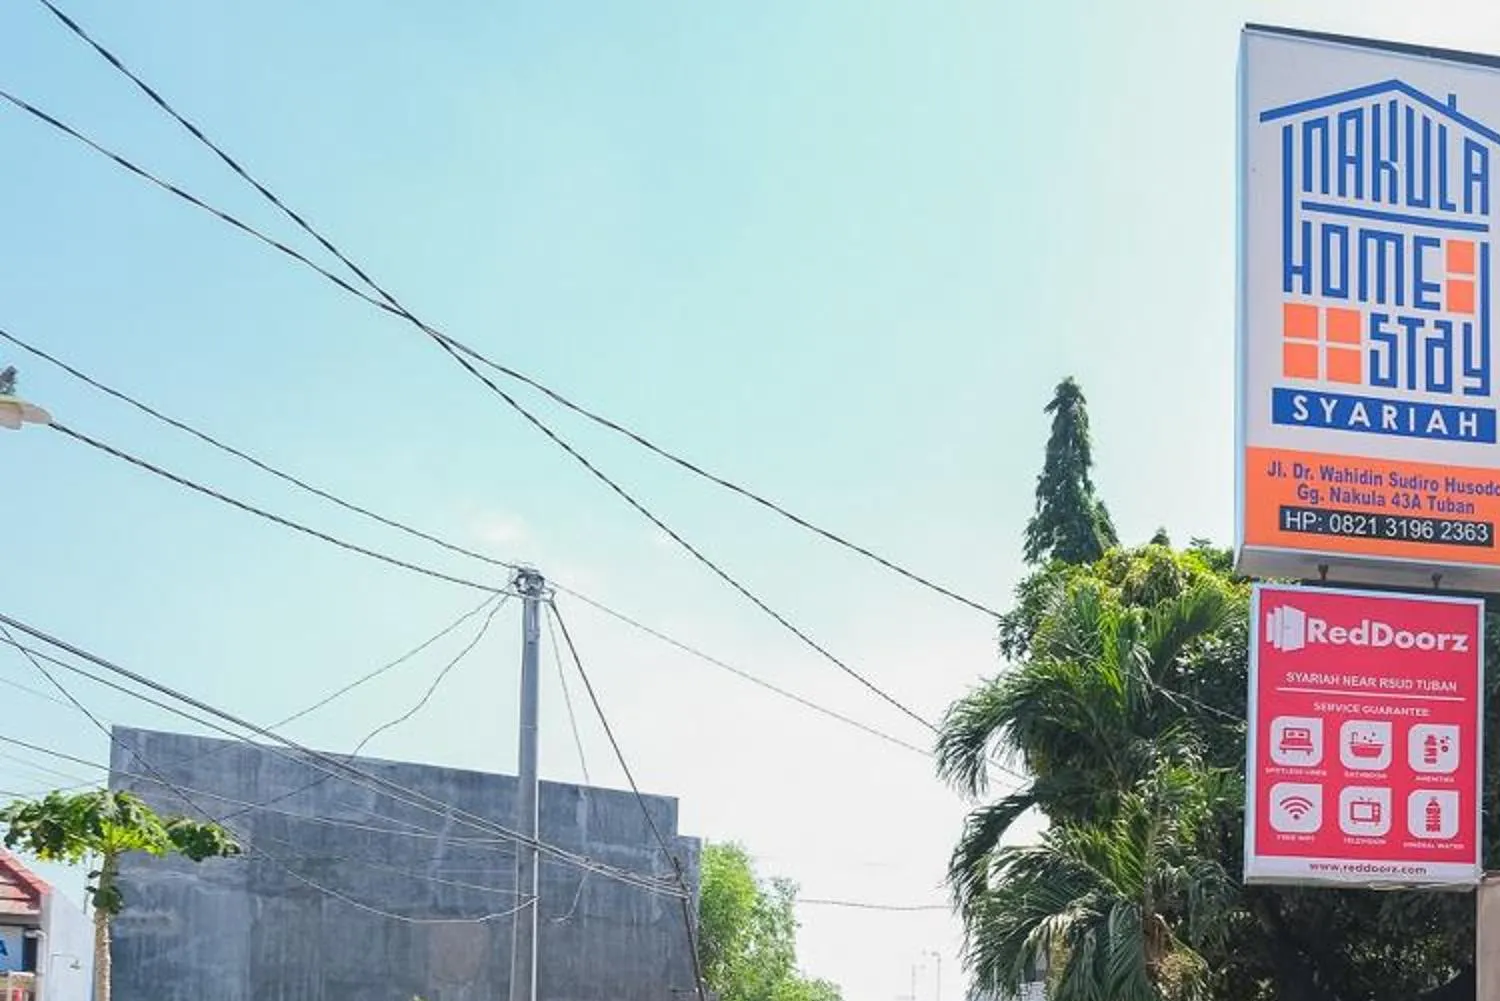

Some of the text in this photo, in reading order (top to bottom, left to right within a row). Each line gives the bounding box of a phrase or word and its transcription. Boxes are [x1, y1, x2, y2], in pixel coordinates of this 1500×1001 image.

[1292, 395, 1477, 437] SYARIAH
[1267, 461, 1287, 478] Jl.
[1292, 463, 1315, 481] Dr.
[1319, 464, 1383, 487] Wahidin
[1388, 471, 1440, 492] Sudiro
[1296, 483, 1476, 514] Gg. Nakula 43A Tuban
[1284, 510, 1489, 543] HP: 0821 3196 2363
[1306, 617, 1469, 653] RedDoorz
[1285, 671, 1458, 693] SYARIAH NEAR RSUD TUBAN
[1313, 701, 1361, 714] SERVICE
[1309, 862, 1428, 876] www.reddoorz.com
